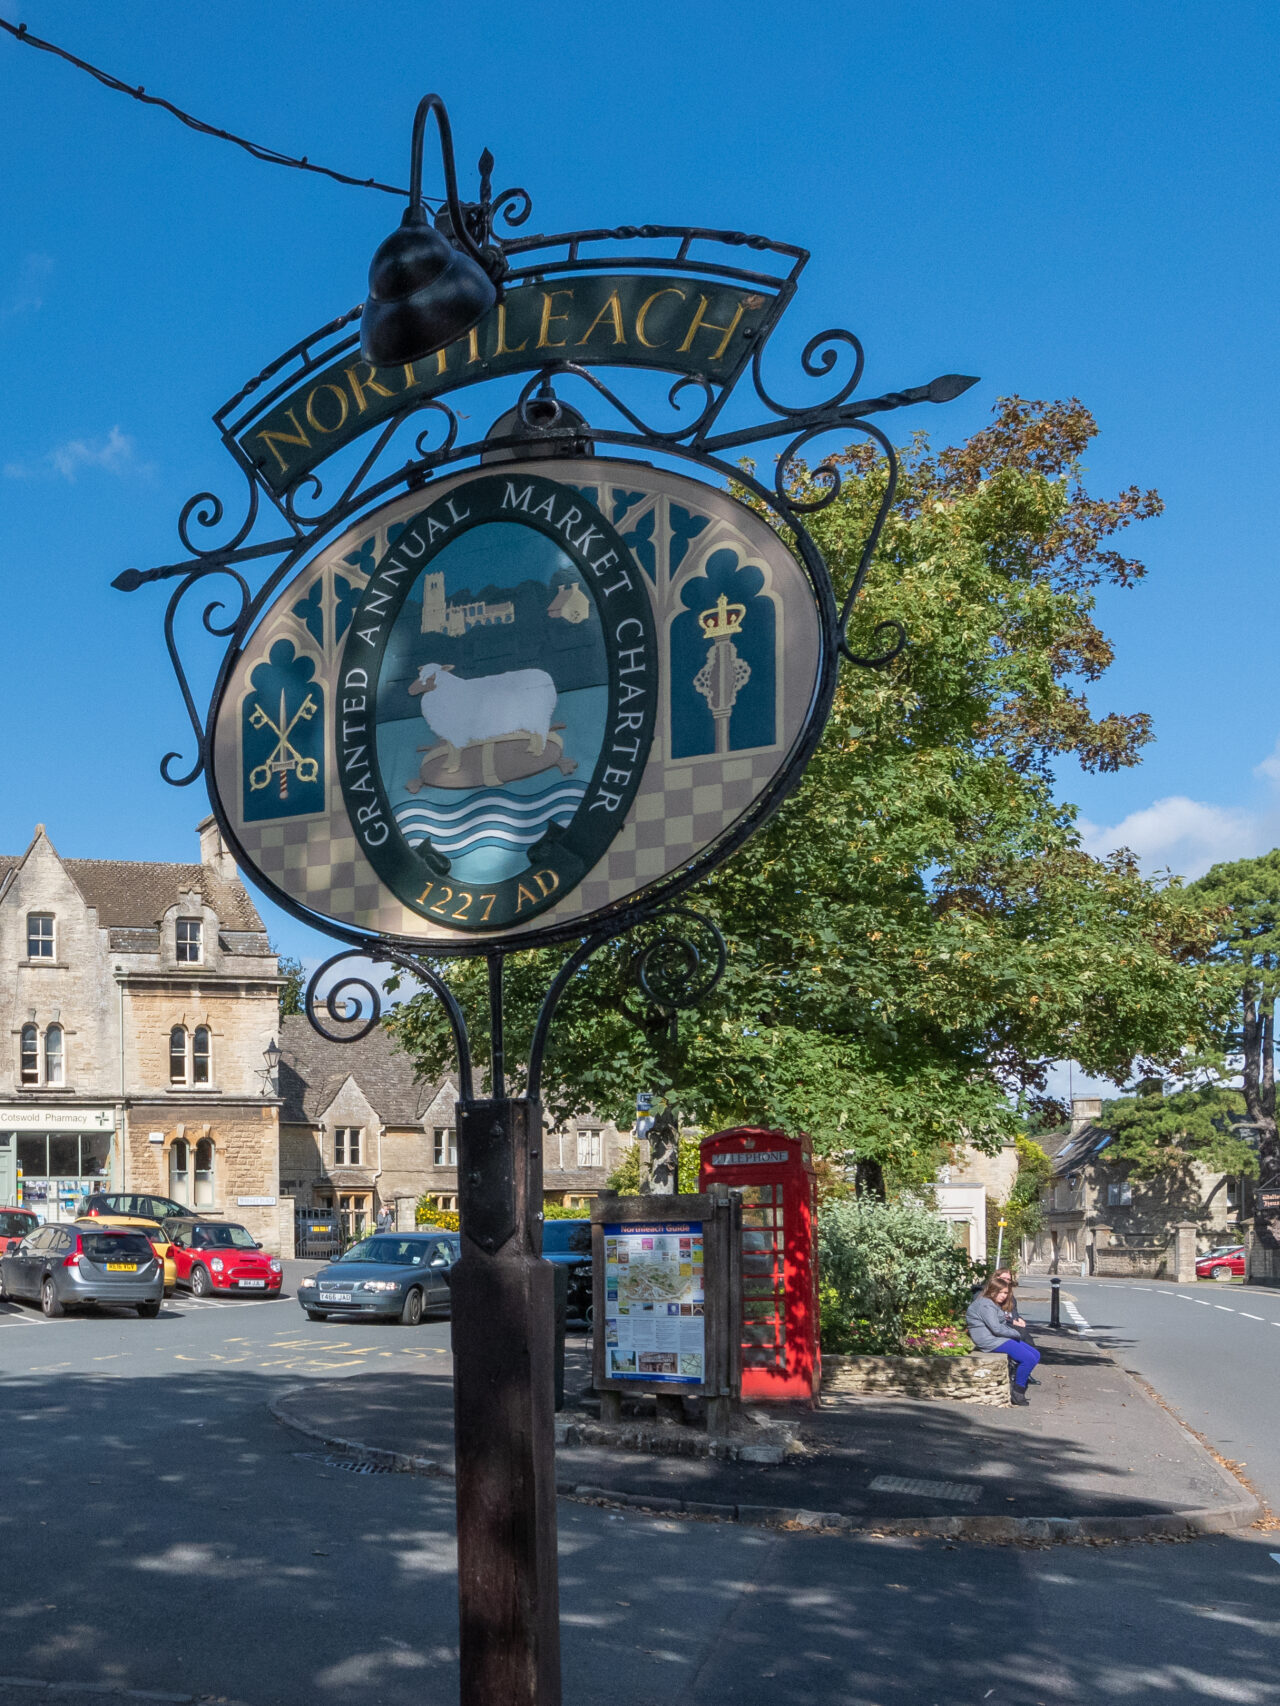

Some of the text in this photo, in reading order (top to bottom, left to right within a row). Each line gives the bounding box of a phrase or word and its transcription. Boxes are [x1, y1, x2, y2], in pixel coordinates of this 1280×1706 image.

[341, 480, 646, 848] GRANTED ANNUAL MARKET CHARTER
[415, 867, 561, 922] 1227 AD
[1, 1113, 40, 1122] Cotswold
[45, 1113, 88, 1124] Pharmacy
[620, 1224, 690, 1233] Northleach Guide
